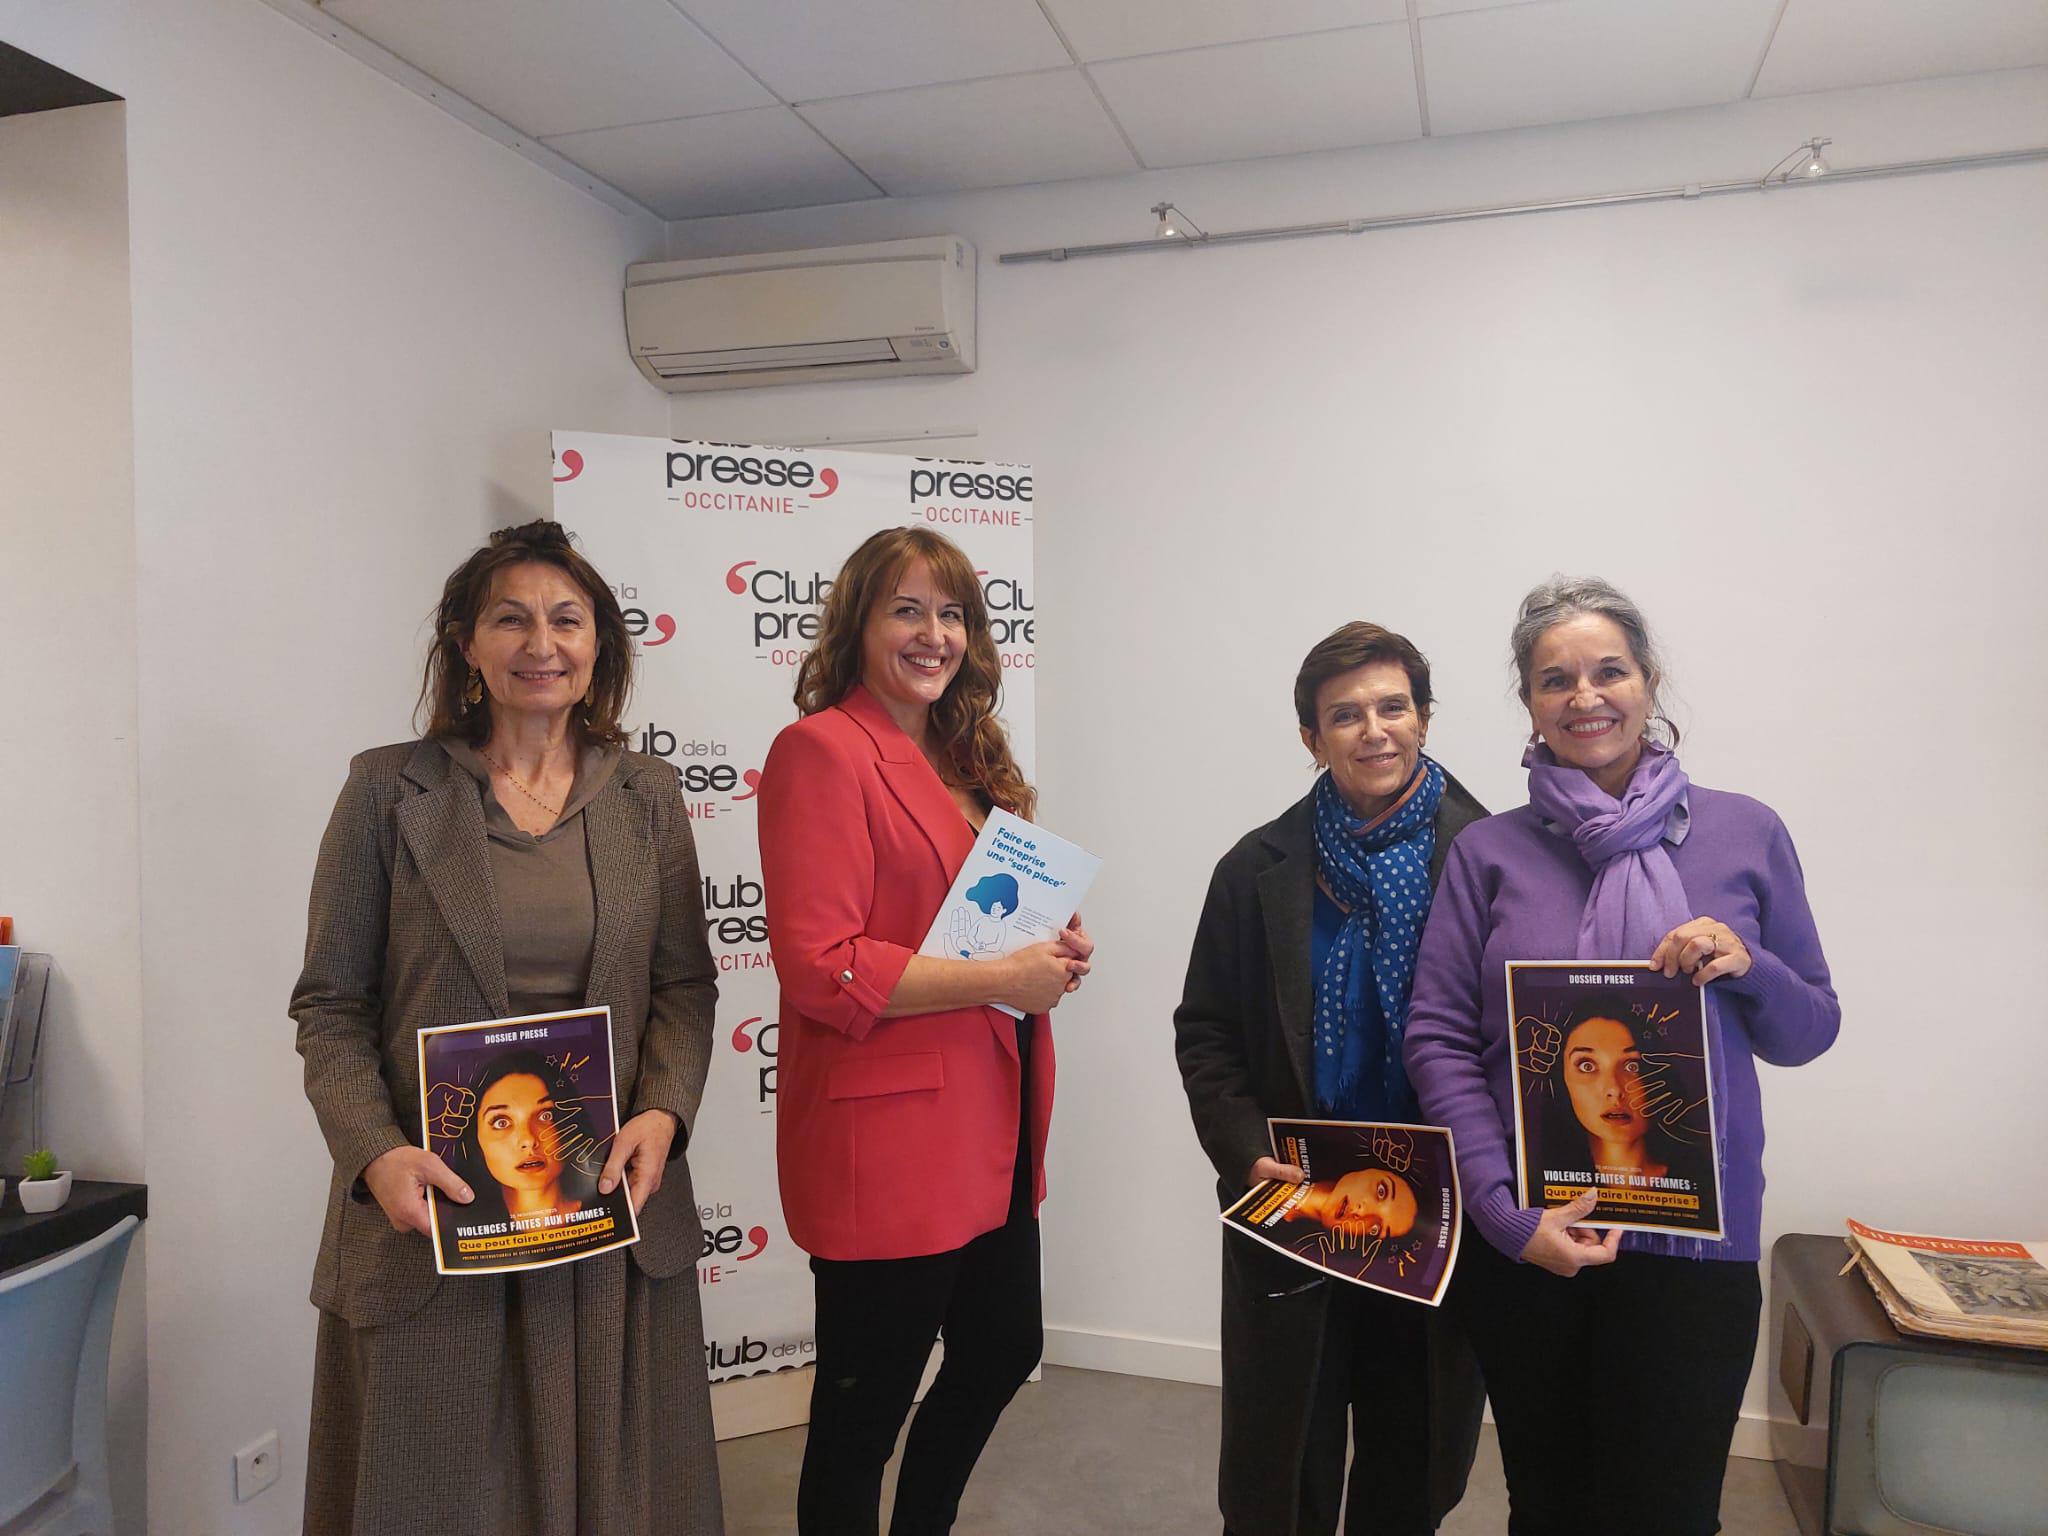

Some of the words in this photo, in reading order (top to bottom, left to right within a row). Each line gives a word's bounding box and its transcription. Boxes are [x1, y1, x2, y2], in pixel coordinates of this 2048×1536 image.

[666, 451, 814, 488] presse
[684, 491, 794, 514] OCCITANIE
[926, 506, 1021, 526] OCCITANIE
[621, 582, 637, 600] la
[985, 579, 1034, 611] Clu
[755, 612, 823, 647] pre
[682, 740, 708, 756] de
[711, 740, 726, 756] la
[997, 827, 1022, 844] Faire
[1023, 840, 1036, 851] de
[987, 850, 1005, 863] une
[992, 837, 1046, 868] l'entreprise
[701, 874, 763, 909] lub
[1569, 974, 1602, 984] DOSSIER
[1604, 974, 1635, 984] PRESSE
[485, 1031, 517, 1044] DOSSIER
[520, 1028, 549, 1040] PRESSE
[1543, 1170, 1593, 1183] VIOLENCES
[1595, 1173, 1626, 1185] FAITES
[1628, 1175, 1647, 1187] AUX
[1650, 1176, 1691, 1190] FEMMES
[1442, 1187, 1450, 1219] DOSSIER
[1546, 1188, 1567, 1197] Que
[1597, 1189, 1622, 1200] faire
[1625, 1191, 1689, 1205] l'entreprise
[457, 1222, 507, 1237] VIOLENCES
[510, 1218, 541, 1232] FAITES
[544, 1215, 563, 1226] AUX
[565, 1207, 605, 1224] FEMMES
[717, 1203, 732, 1219] la
[459, 1242, 481, 1251] Que
[485, 1239, 509, 1250] peut
[513, 1235, 539, 1245] faire
[542, 1223, 605, 1241] l'entreprise
[704, 1336, 767, 1370] lub
[772, 1344, 796, 1357] de
[800, 1340, 814, 1353] la
